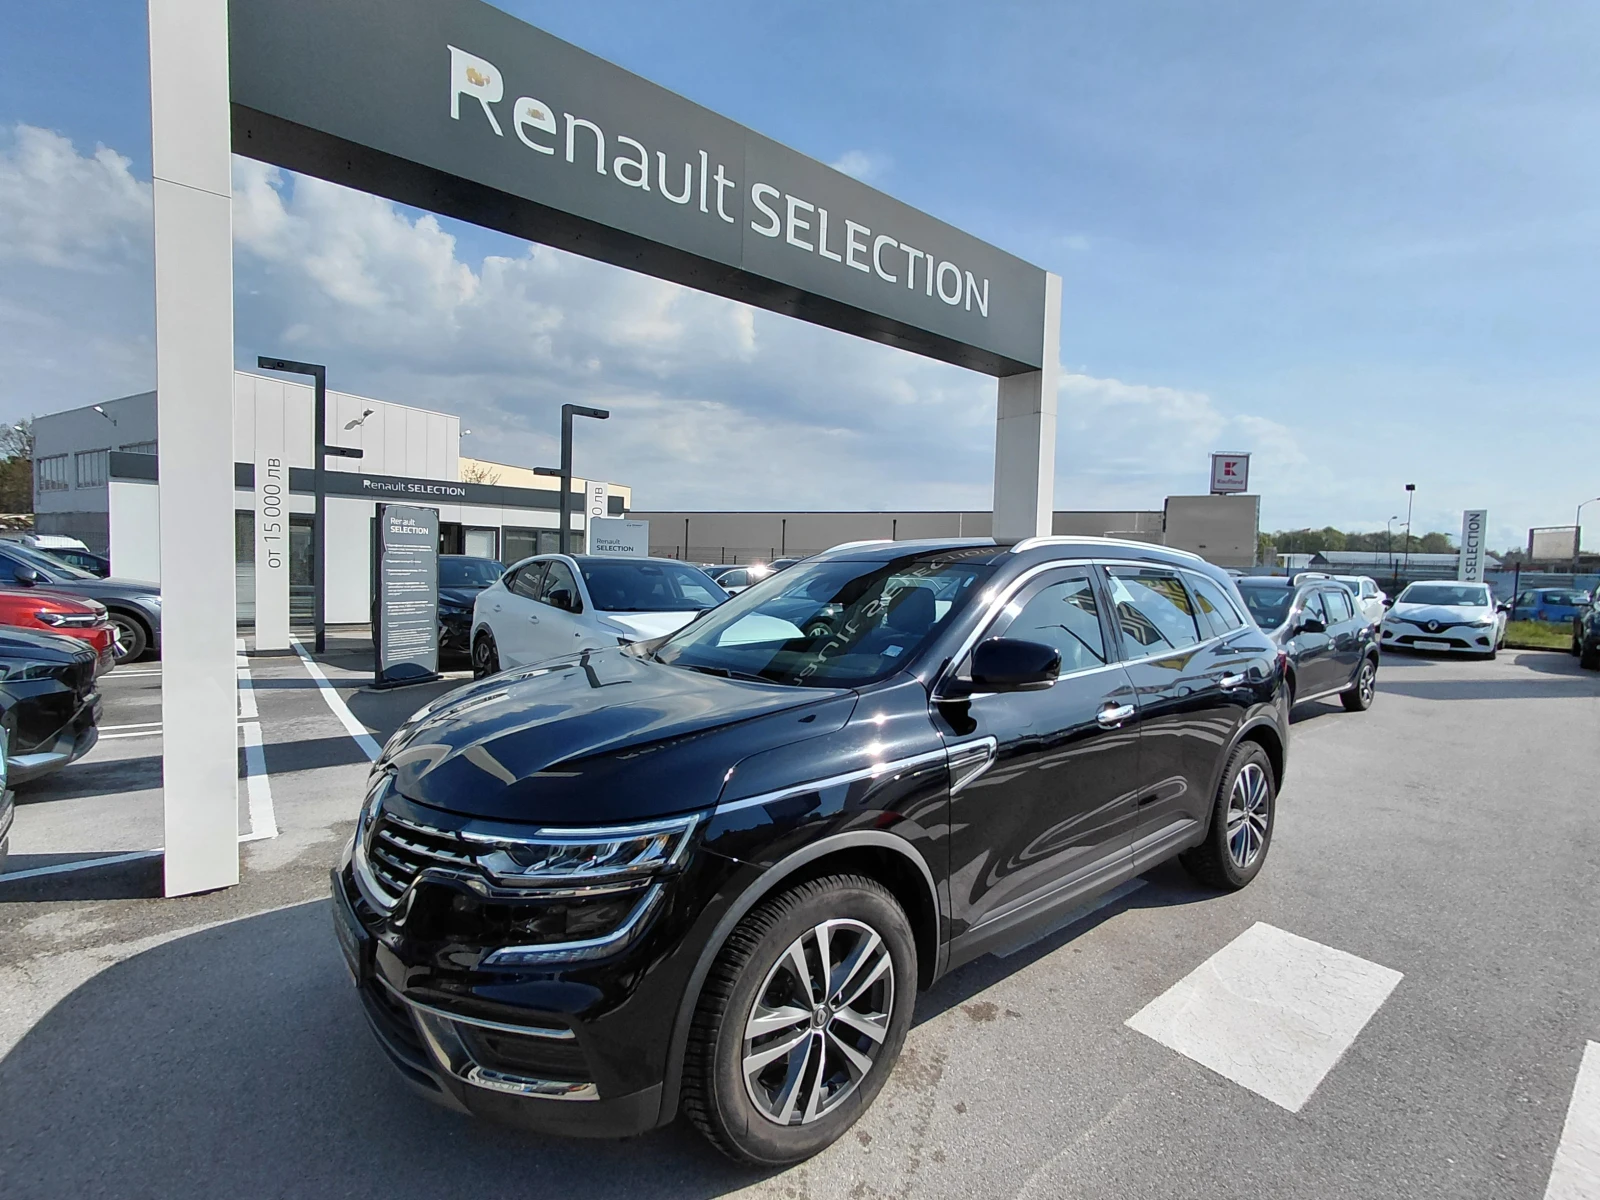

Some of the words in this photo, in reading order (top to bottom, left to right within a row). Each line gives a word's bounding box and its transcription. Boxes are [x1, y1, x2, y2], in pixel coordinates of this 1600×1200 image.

[446, 43, 735, 224] Renault
[750, 181, 990, 318] SELECTION
[363, 479, 406, 492] Renault
[407, 483, 466, 496] SELECTION
[263, 484, 281, 518] 000
[263, 523, 281, 543] 15
[390, 525, 429, 535] SELECTION
[596, 544, 634, 552] SELECTION
[1465, 513, 1481, 574] SELECTION
